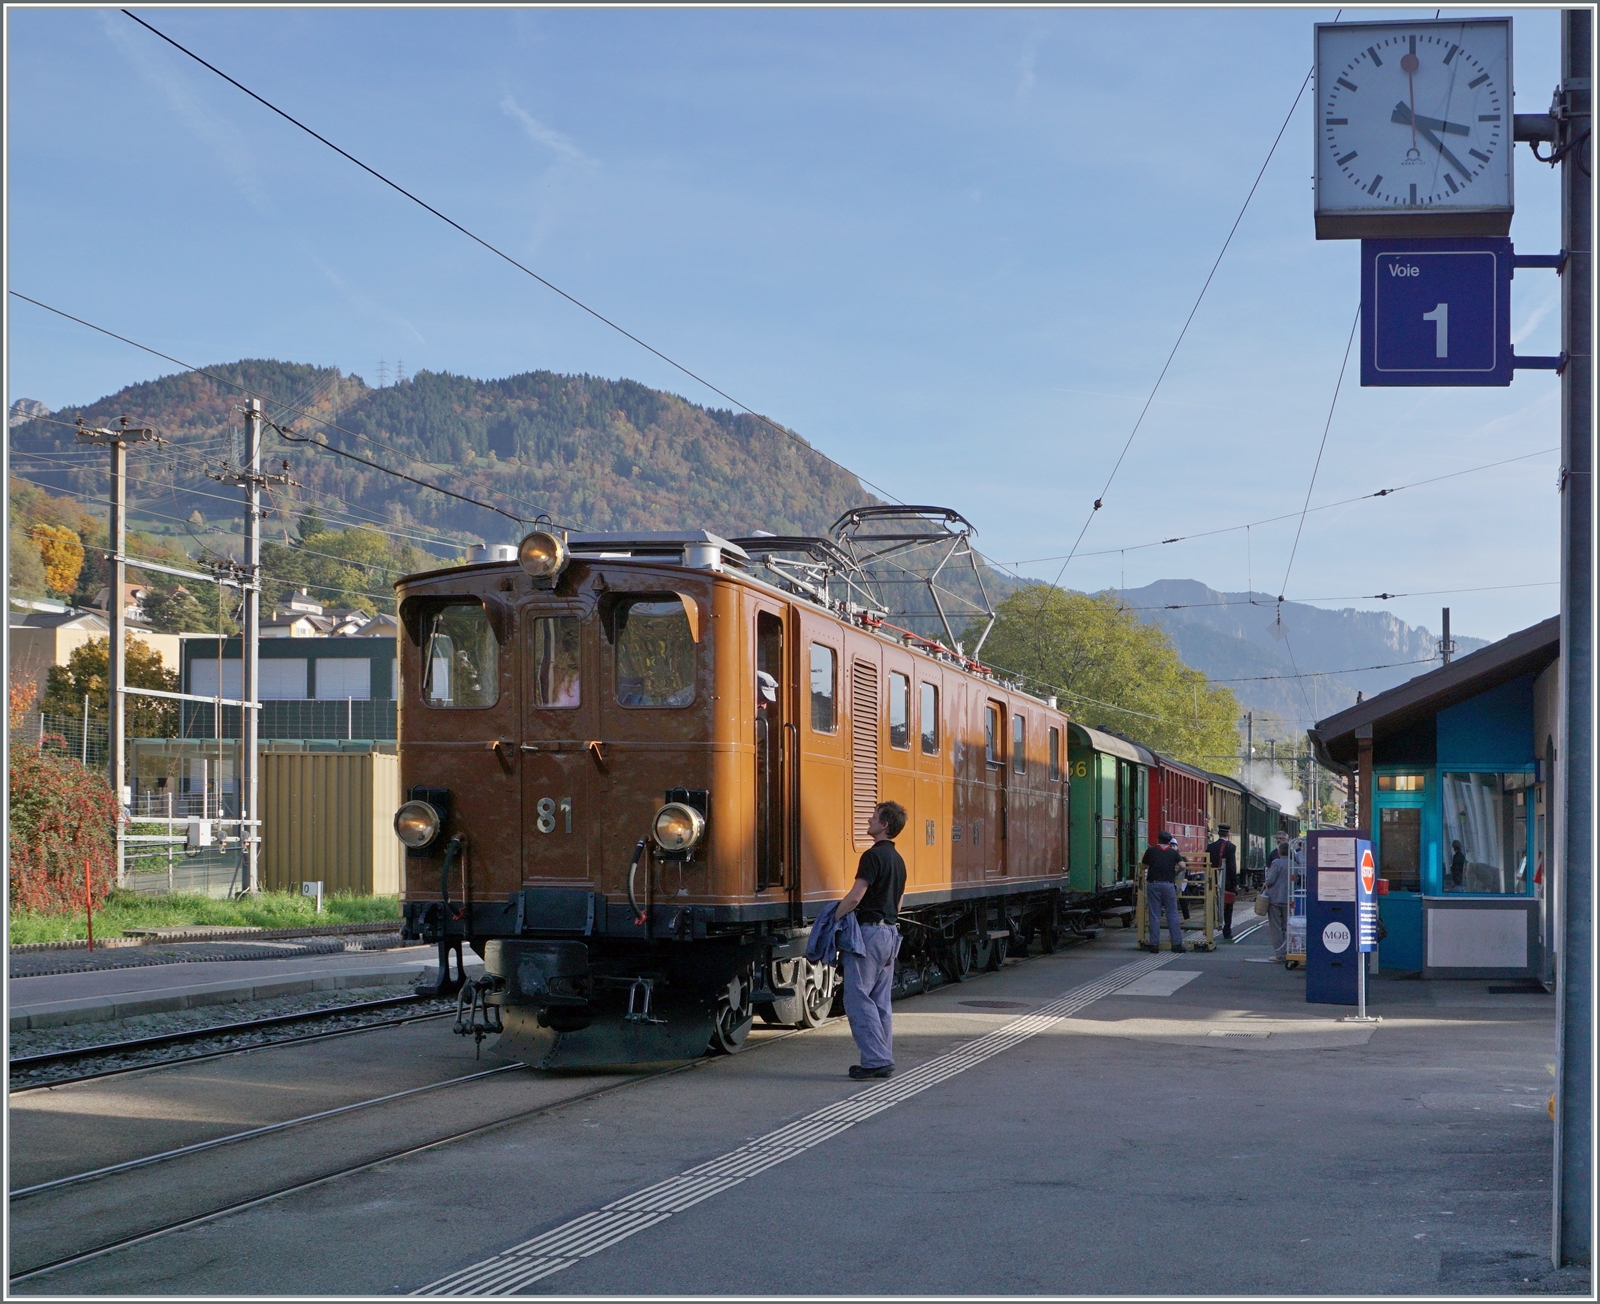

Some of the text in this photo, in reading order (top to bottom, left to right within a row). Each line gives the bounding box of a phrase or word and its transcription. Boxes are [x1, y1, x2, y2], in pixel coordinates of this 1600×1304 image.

[1388, 263, 1420, 277] Voie
[1422, 303, 1448, 358] 1
[537, 797, 572, 834] 81
[1362, 866, 1374, 878] STOP
[1324, 931, 1349, 940] MOB
